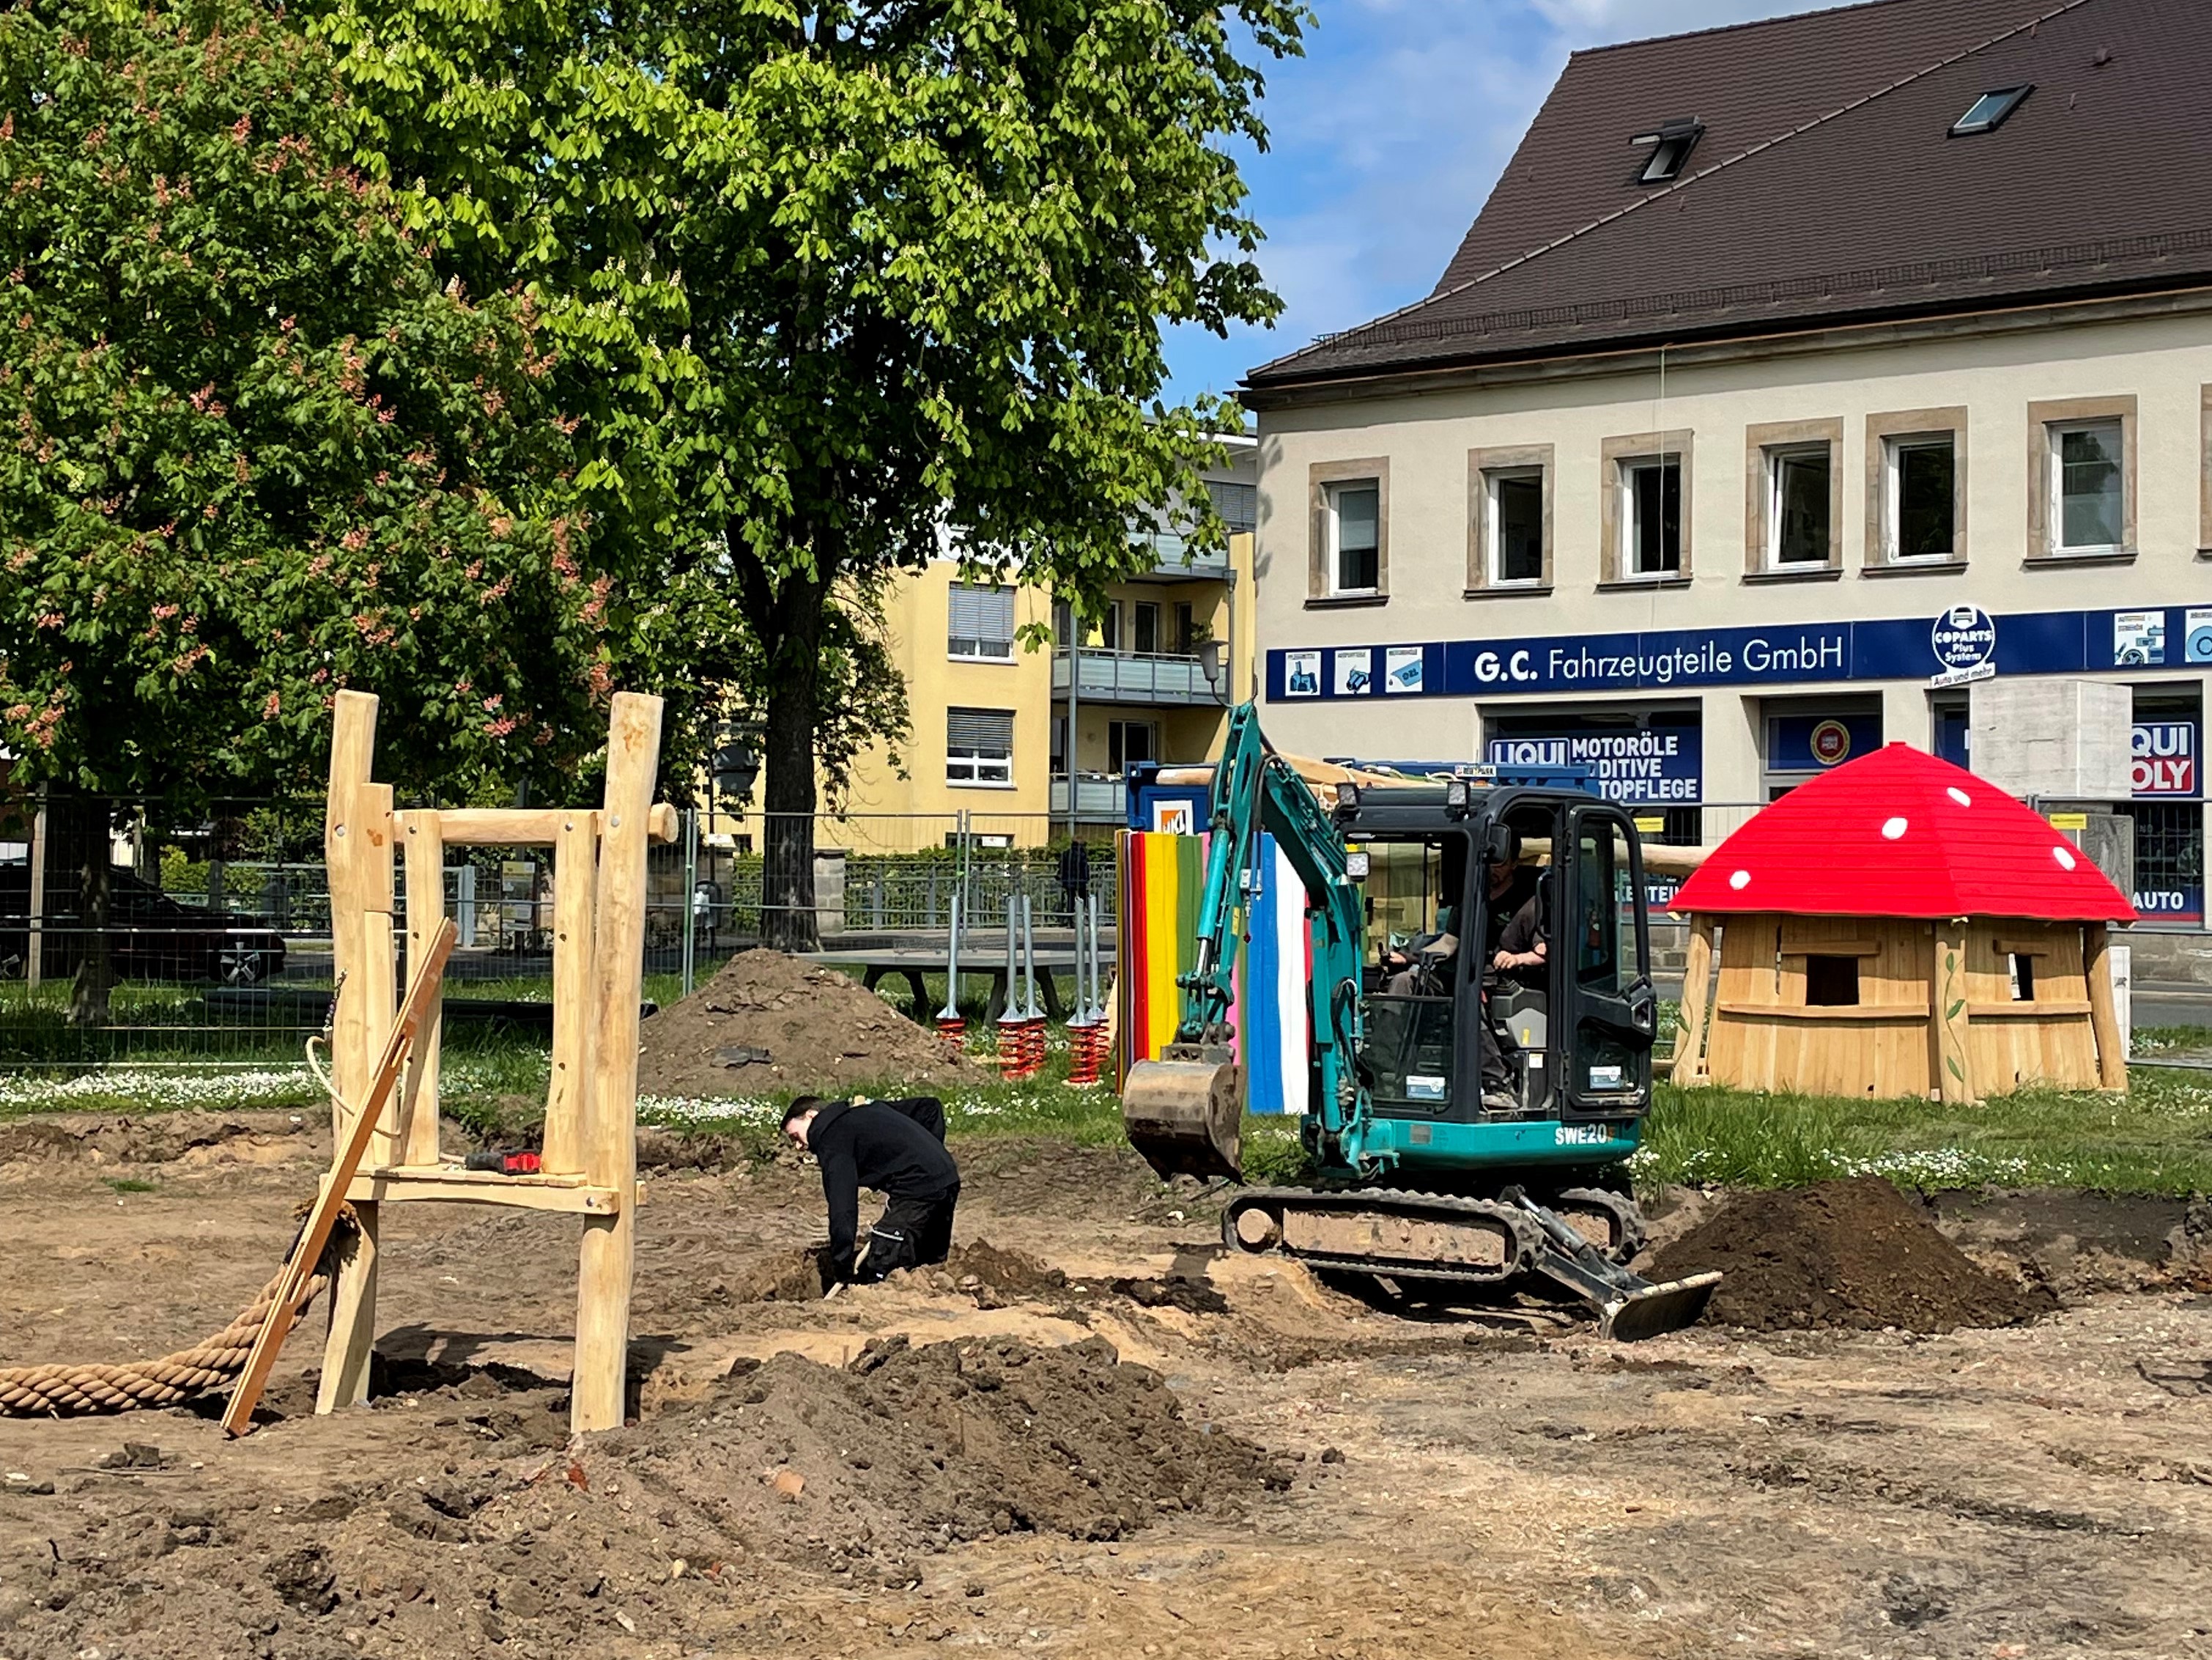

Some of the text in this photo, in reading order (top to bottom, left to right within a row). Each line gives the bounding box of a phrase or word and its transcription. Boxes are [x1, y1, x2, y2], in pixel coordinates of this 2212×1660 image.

[1935, 630, 1992, 643] COPARTS
[1945, 652, 1982, 664] System
[1952, 643, 1975, 653] Plus
[1474, 635, 1842, 683] G.C. Fahrzeugteile GmbH
[1572, 731, 1678, 758] MOTORÖLE
[2131, 726, 2188, 758] QUI
[1494, 742, 1566, 765] LIQUI
[1575, 758, 1662, 778] DITIVE
[2131, 760, 2191, 791] OLY
[1598, 779, 1697, 800] TOPFLEGE
[2133, 891, 2184, 910] AUTO
